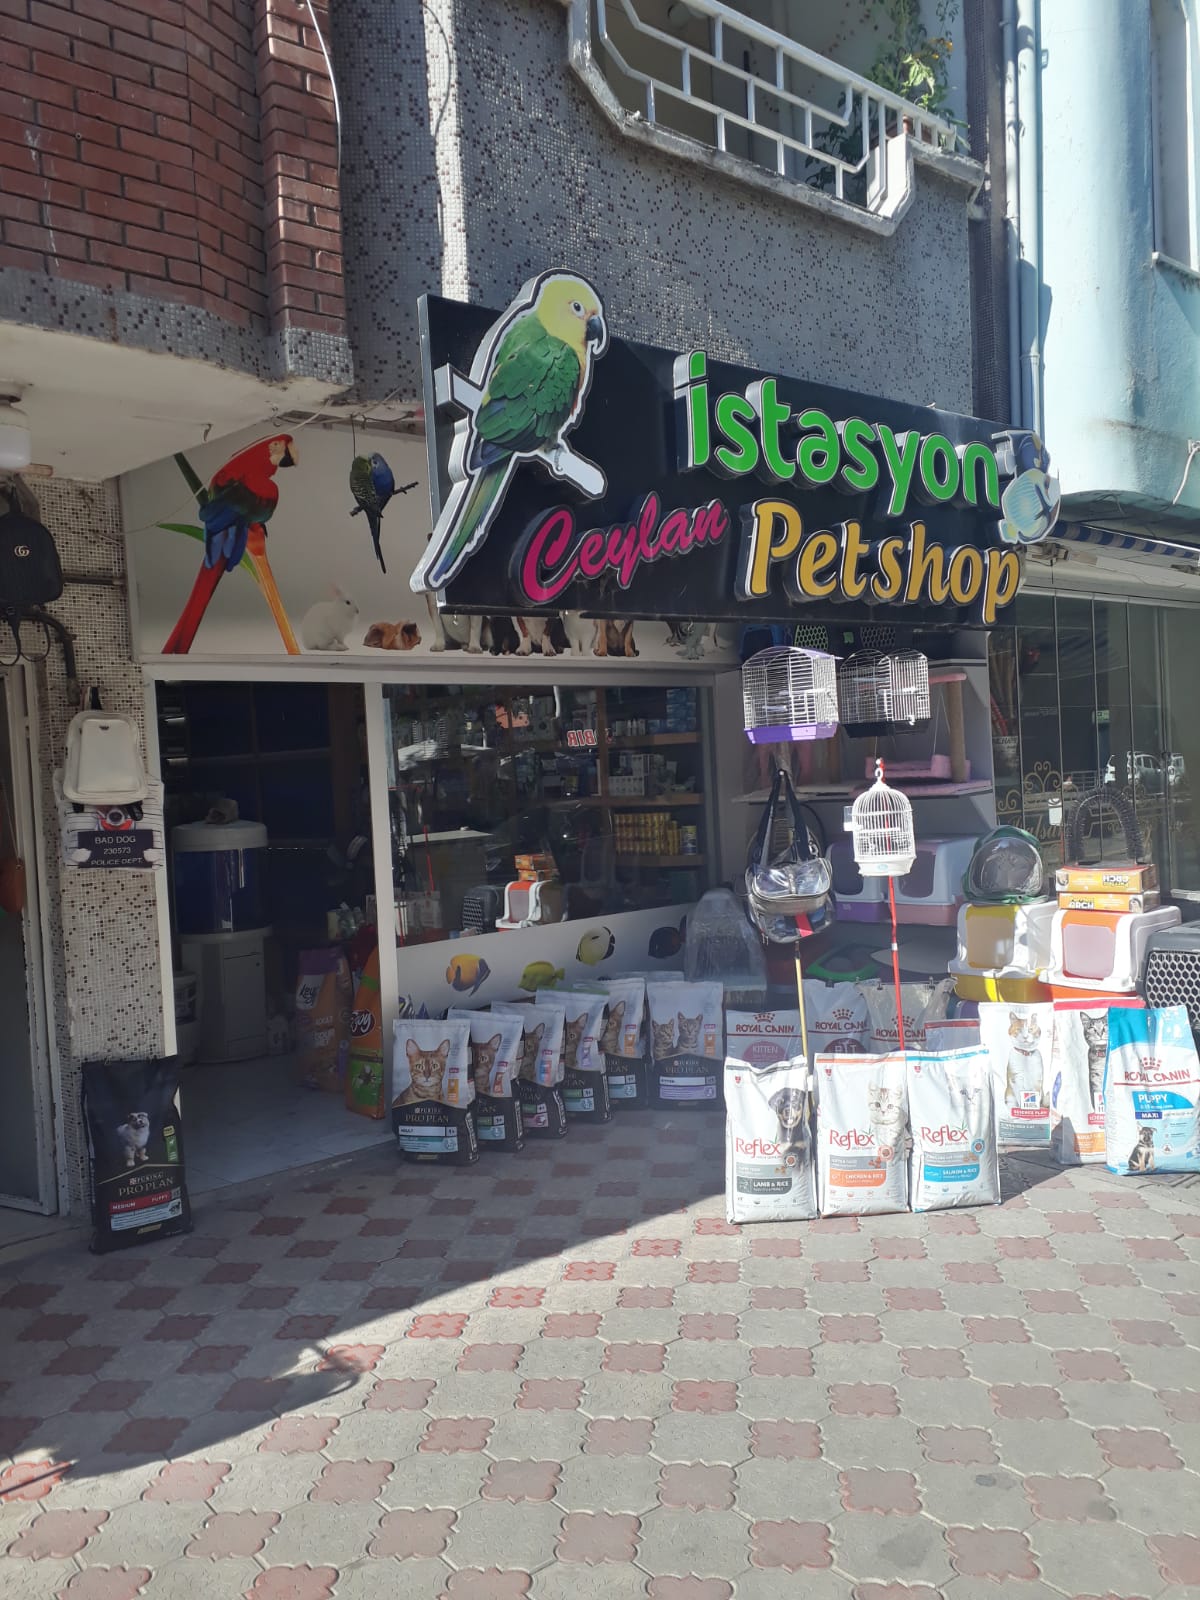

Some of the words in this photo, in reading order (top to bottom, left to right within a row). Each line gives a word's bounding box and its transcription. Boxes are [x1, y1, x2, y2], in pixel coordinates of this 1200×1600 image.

[521, 494, 729, 602] Ceylan
[744, 497, 1022, 625] Petshop
[95, 837, 114, 845] BAD
[116, 836, 136, 844] DOG
[103, 847, 131, 855] 230573
[735, 1023, 763, 1033] ROYAL
[764, 1024, 795, 1033] CANIN
[815, 1021, 842, 1031] ROYAL
[752, 1045, 779, 1055] KITTEN
[1124, 1071, 1152, 1083] ROYAL
[1153, 1069, 1191, 1082] CANIN
[405, 1114, 425, 1122] PRO
[426, 1114, 449, 1123] PLAN
[829, 1127, 876, 1150] Reflex
[921, 1124, 969, 1146] Reflex
[736, 1137, 783, 1158] Reflex
[119, 1183, 144, 1196] PRO
[145, 1177, 174, 1192] PLAN
[112, 1202, 136, 1210] MEDIUM
[151, 1194, 169, 1203] PUPPY
